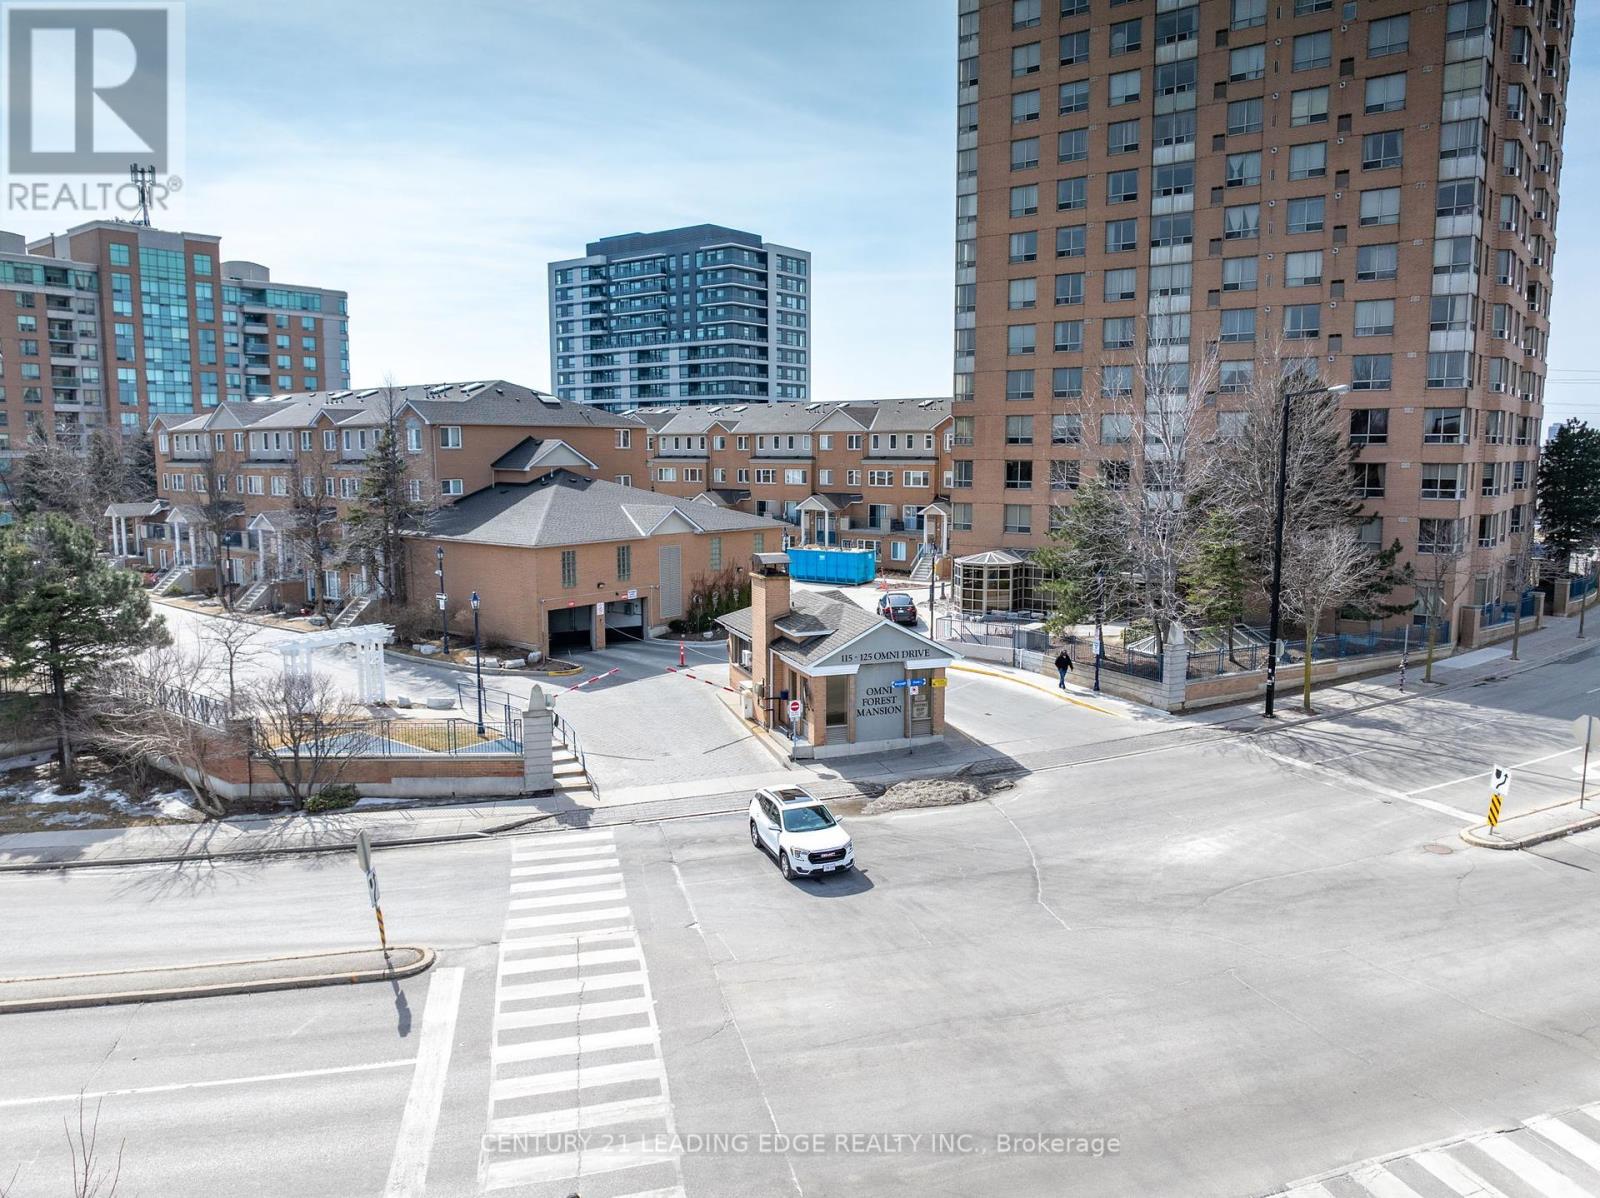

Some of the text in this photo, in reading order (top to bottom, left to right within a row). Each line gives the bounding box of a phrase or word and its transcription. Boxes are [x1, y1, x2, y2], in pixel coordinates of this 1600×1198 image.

[841, 654, 853, 662] 115
[860, 653, 873, 661] 125
[874, 651, 899, 660] OMNI
[902, 649, 930, 659] DRIVE
[866, 686, 893, 696] OMNI
[862, 696, 898, 706] FOREST
[857, 705, 902, 717] MANSION
